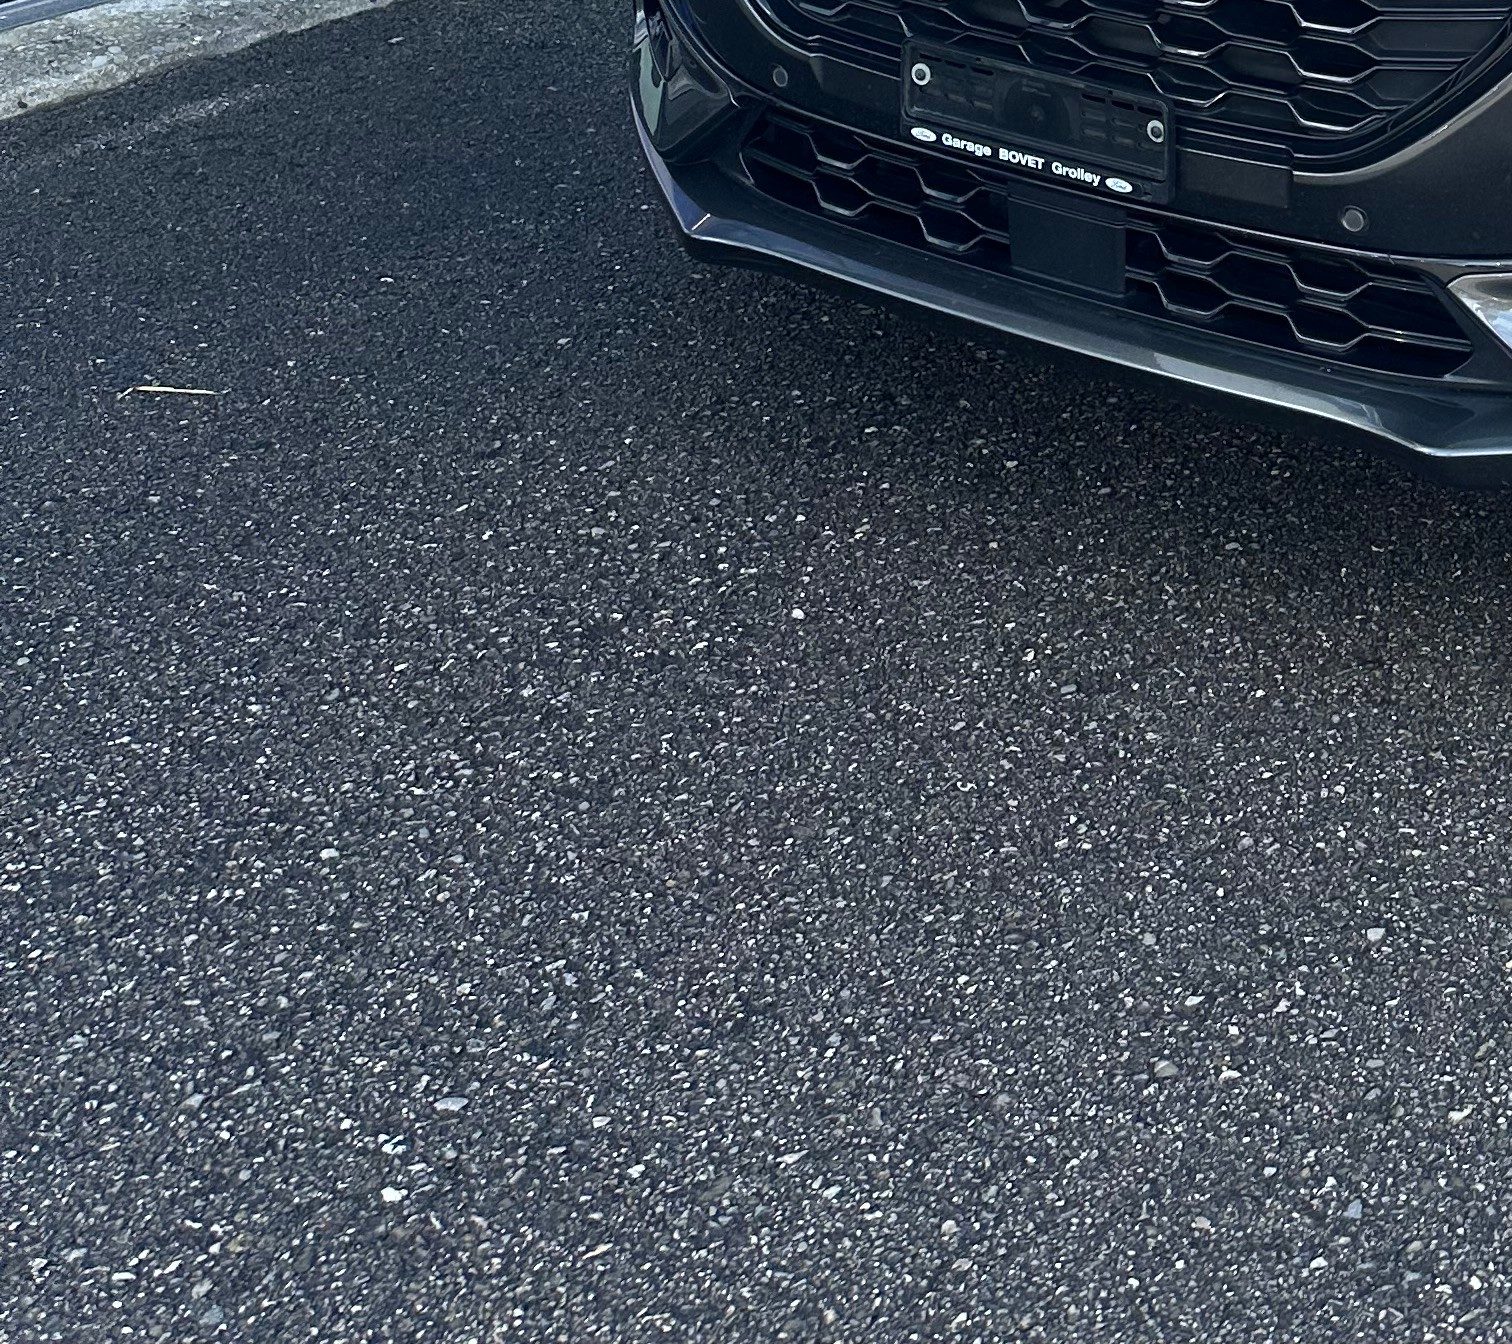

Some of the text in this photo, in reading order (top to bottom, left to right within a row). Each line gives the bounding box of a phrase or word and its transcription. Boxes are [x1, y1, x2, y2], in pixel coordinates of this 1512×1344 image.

[941, 133, 1101, 187] Garage BOVET Grolley
